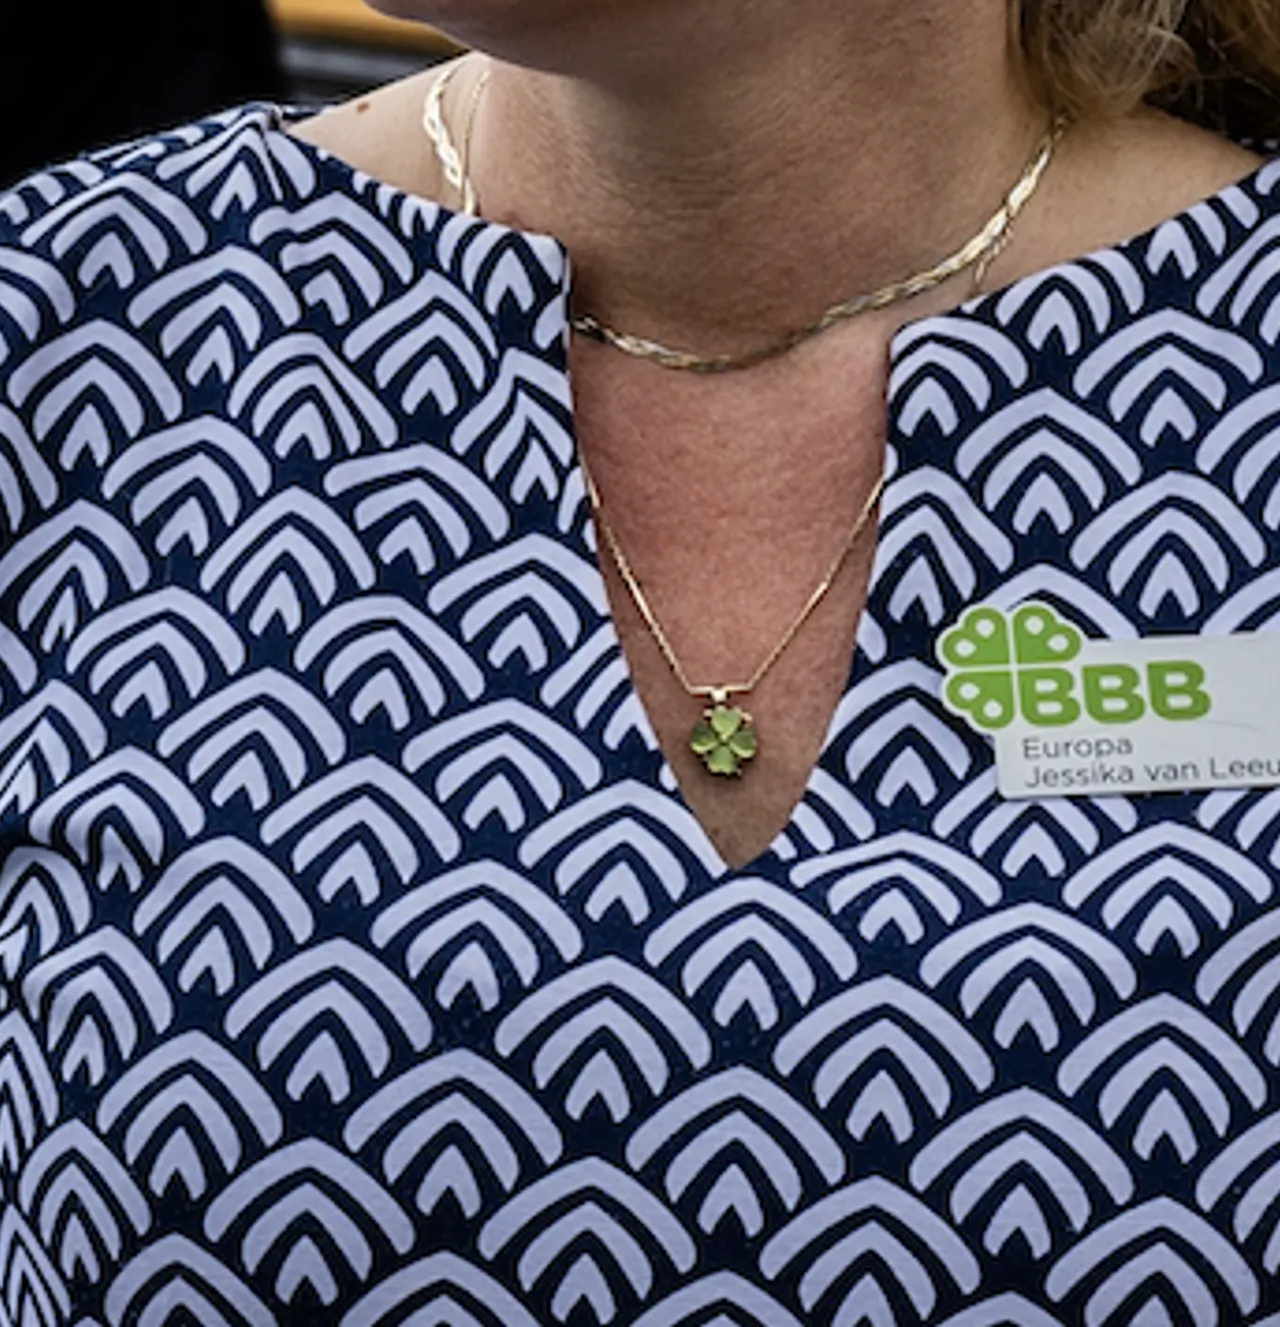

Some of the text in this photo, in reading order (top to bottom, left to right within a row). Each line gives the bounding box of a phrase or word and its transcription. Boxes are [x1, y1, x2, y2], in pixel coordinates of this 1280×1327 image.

[1019, 660, 1212, 727] BBB
[1023, 736, 1134, 760] Europa
[1024, 760, 1134, 789] Jessika
[1144, 762, 1200, 782] van
